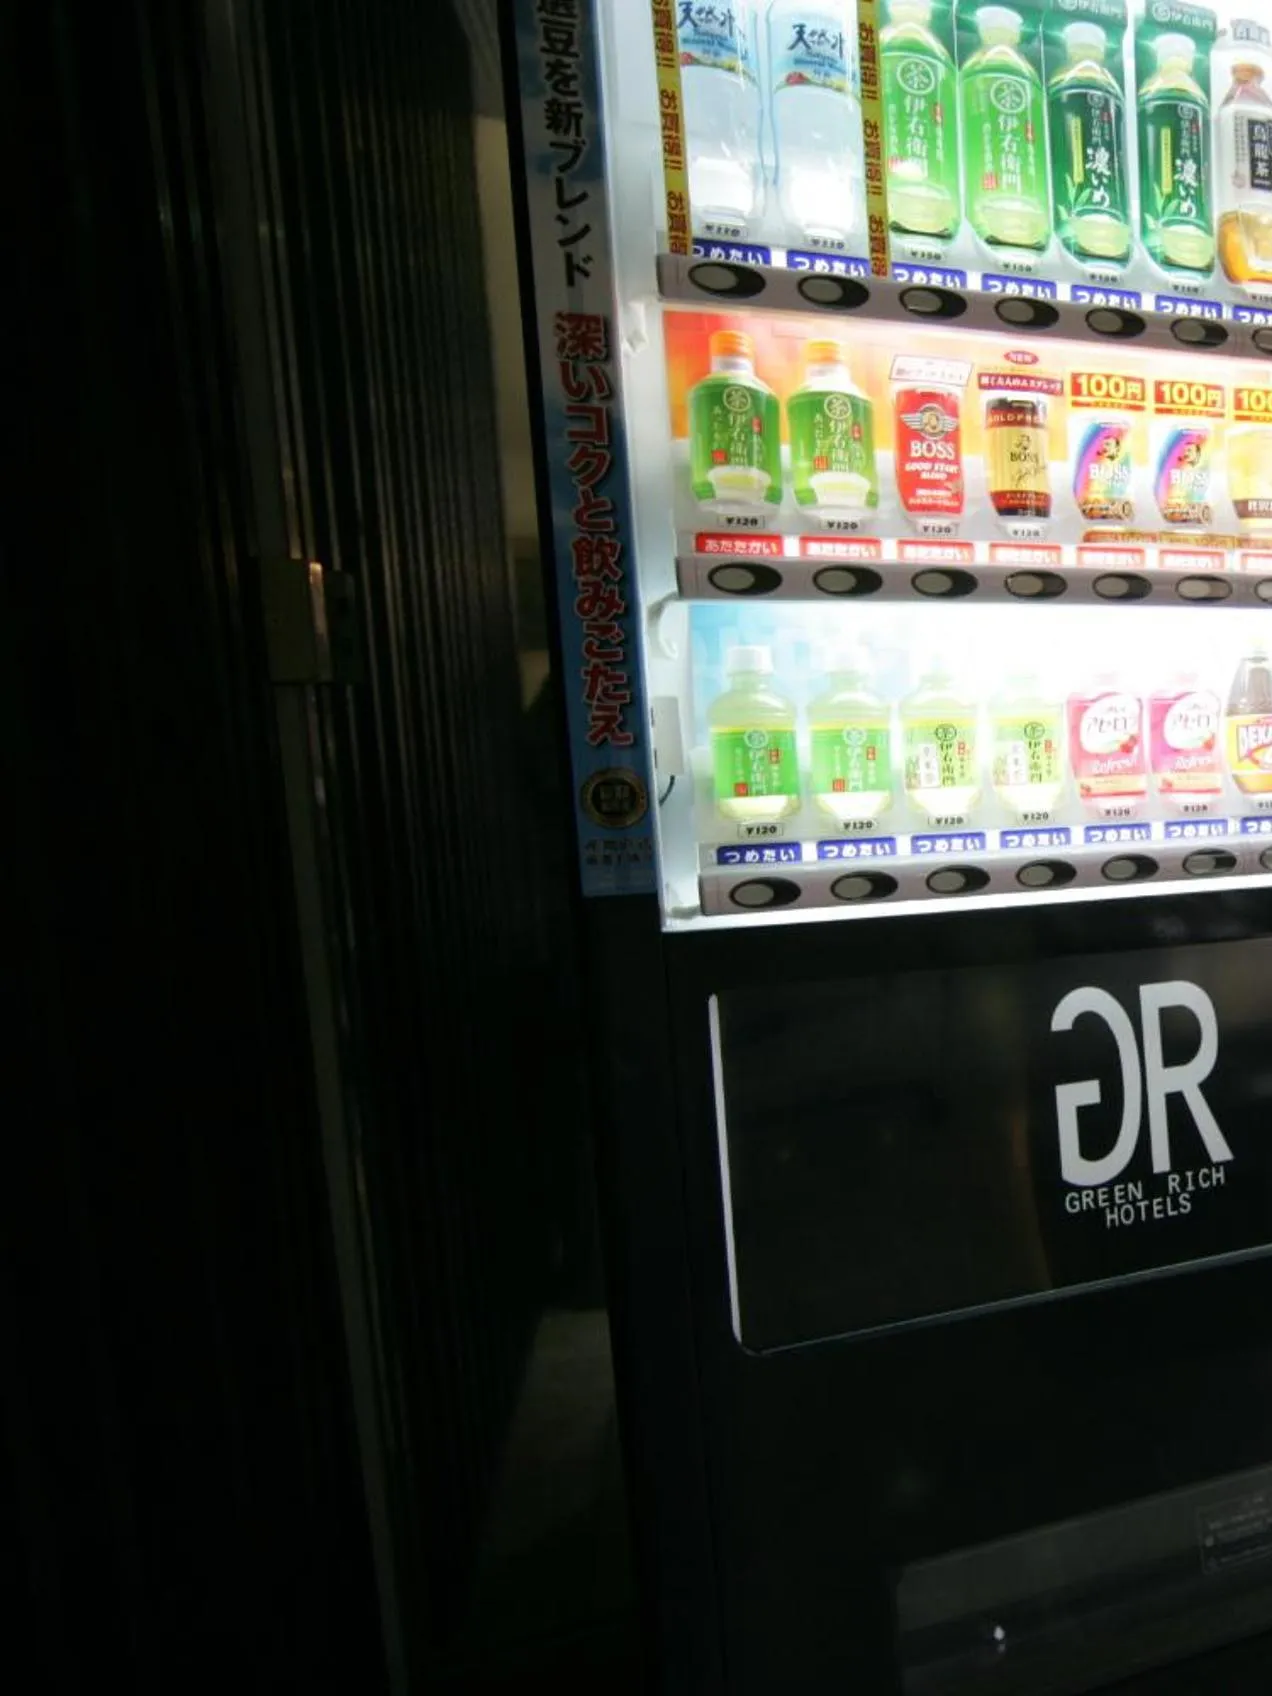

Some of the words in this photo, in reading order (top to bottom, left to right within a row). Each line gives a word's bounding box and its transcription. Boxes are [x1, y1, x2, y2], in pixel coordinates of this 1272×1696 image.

[793, 256, 867, 277] つめたい
[894, 270, 963, 290] つめたい
[987, 280, 1052, 300] つめたい
[1074, 290, 1137, 309] つめたい
[1160, 300, 1218, 319] つめたい
[1078, 375, 1142, 400] 100円
[1161, 382, 1222, 408] 100円
[910, 440, 956, 460] BOSS
[553, 310, 635, 748] 深いコクと飲みごたえ
[705, 538, 778, 554] あたたかい
[843, 820, 874, 831] ¥120
[935, 816, 965, 825] ¥120
[1023, 811, 1049, 822] ¥120
[746, 825, 778, 836] ¥120
[1091, 829, 1147, 843] つめたい
[1168, 824, 1224, 839] つめたい
[917, 837, 981, 854] つめたい
[1005, 832, 1066, 848] つめたい
[723, 848, 796, 864] つめたい
[823, 841, 892, 859] つめたい
[1065, 1180, 1144, 1213] GREEN
[1168, 1165, 1226, 1195] RICH
[1106, 1192, 1192, 1229] HOTELS
